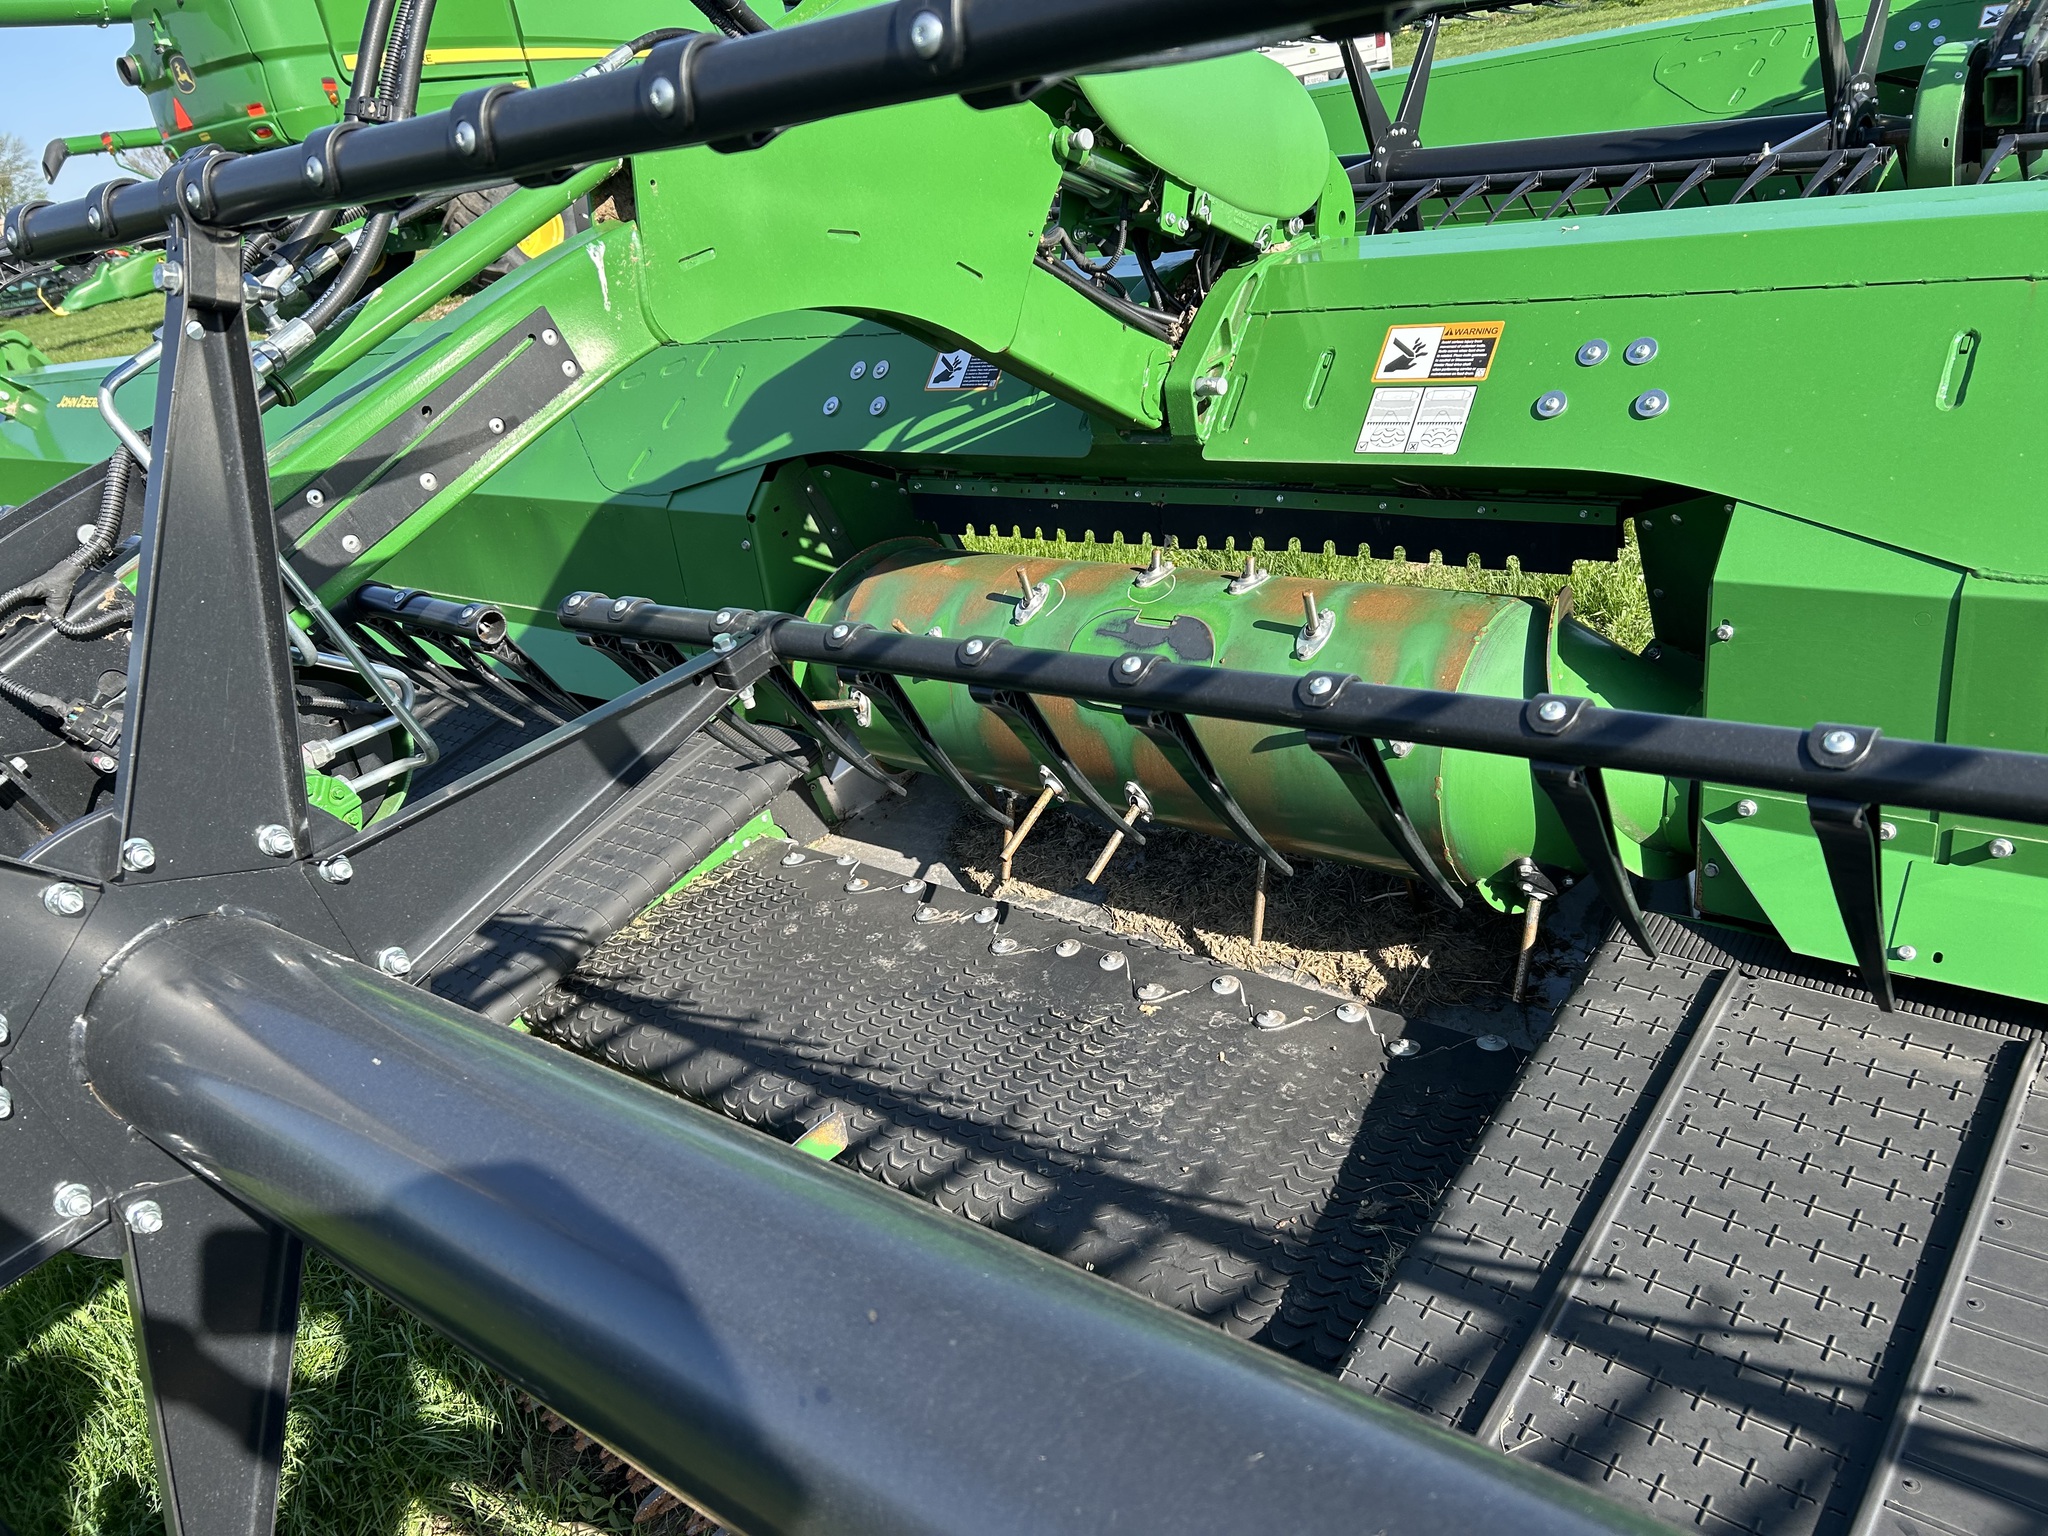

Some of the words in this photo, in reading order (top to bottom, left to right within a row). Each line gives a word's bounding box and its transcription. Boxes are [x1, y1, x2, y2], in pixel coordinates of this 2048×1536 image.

[1454, 327, 1498, 335] WARNING
[56, 395, 78, 408] JOHN
[76, 395, 98, 408] DEER
